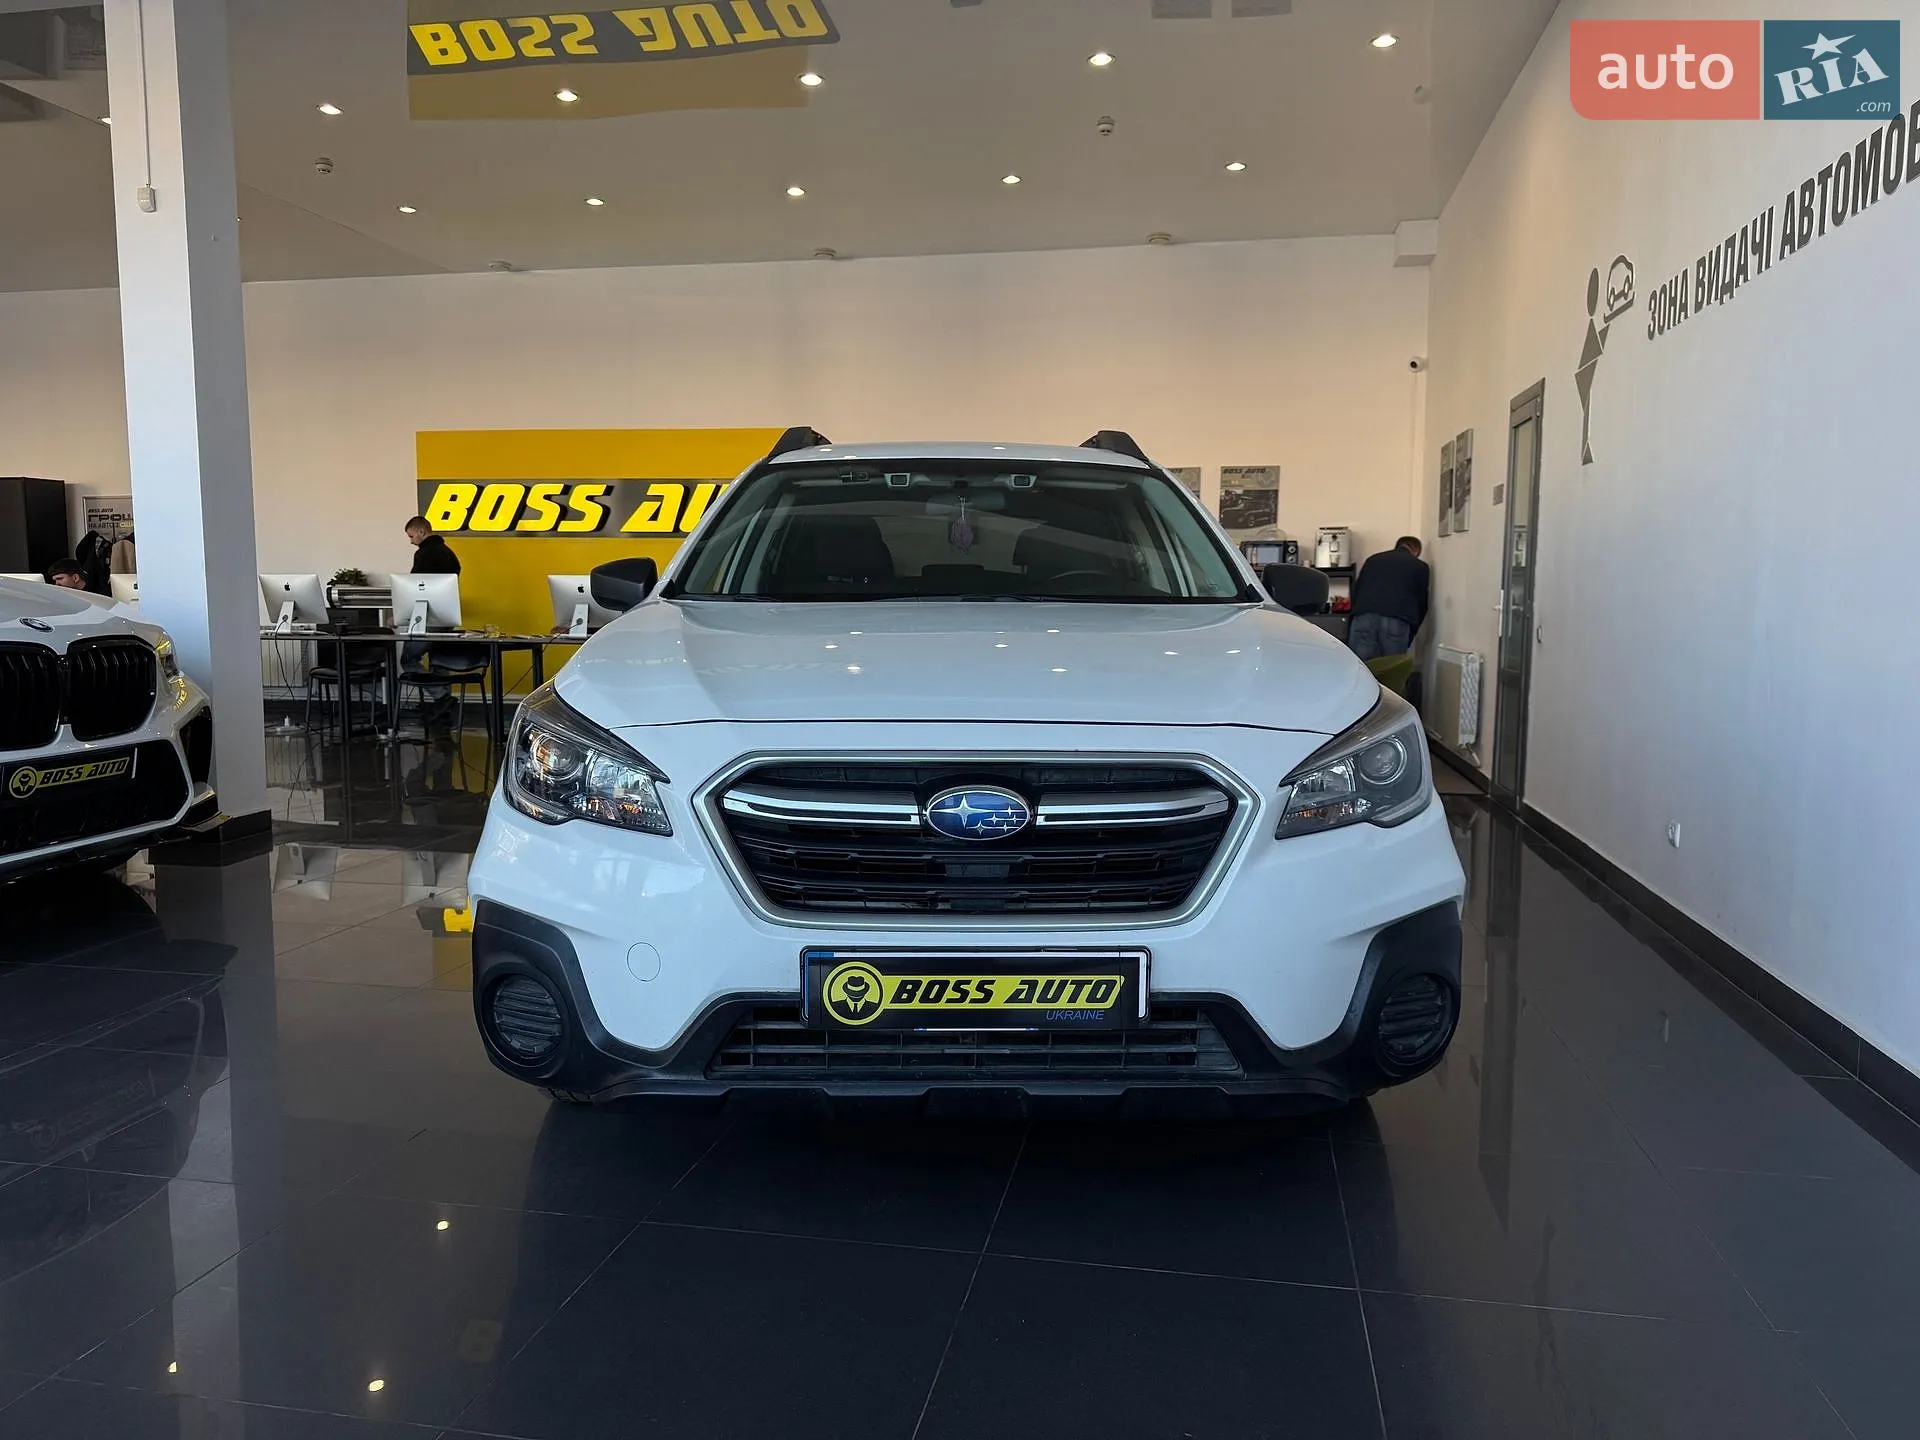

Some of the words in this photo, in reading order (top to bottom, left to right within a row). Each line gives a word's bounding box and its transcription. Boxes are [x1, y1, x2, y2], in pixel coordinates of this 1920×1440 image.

[1647, 267, 1690, 341] ЗОНА
[1694, 206, 1776, 314] ВИДАЧІ
[424, 483, 608, 532] BOSS
[39, 766, 84, 785] BOSS
[86, 760, 126, 778] AUTO
[889, 979, 998, 1004] BOSS
[1003, 979, 1121, 1004] AUTO
[1046, 1010, 1105, 1021] UKRAINE
